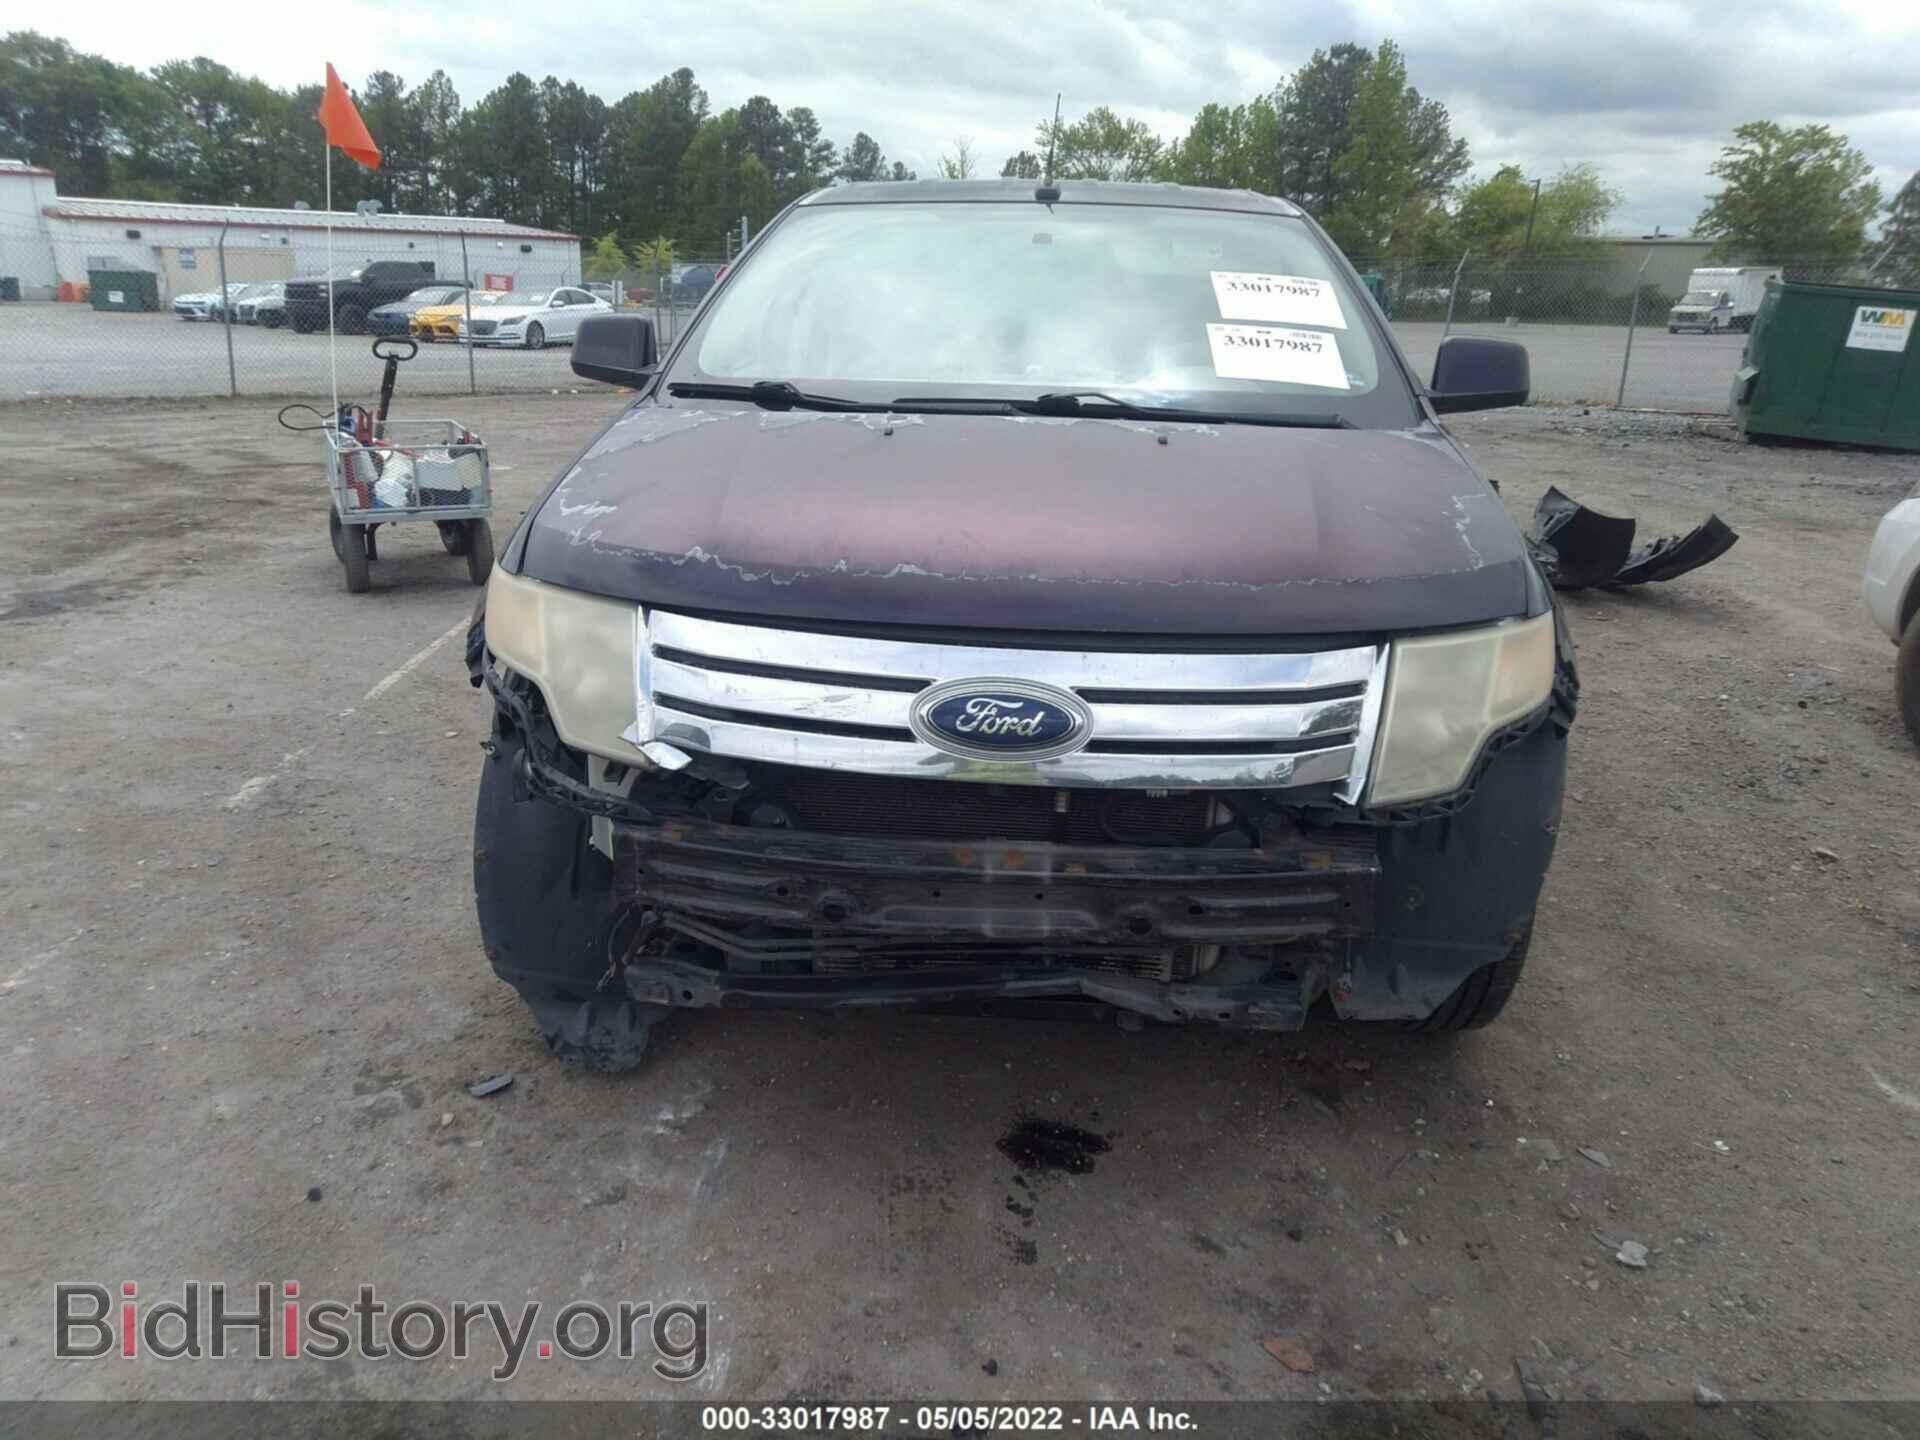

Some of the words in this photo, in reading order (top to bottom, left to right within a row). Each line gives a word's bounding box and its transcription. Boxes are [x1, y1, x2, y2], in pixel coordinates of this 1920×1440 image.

[1226, 280, 1320, 297] 33017987
[1223, 335, 1323, 353] 33017987
[955, 697, 1046, 737] Ford
